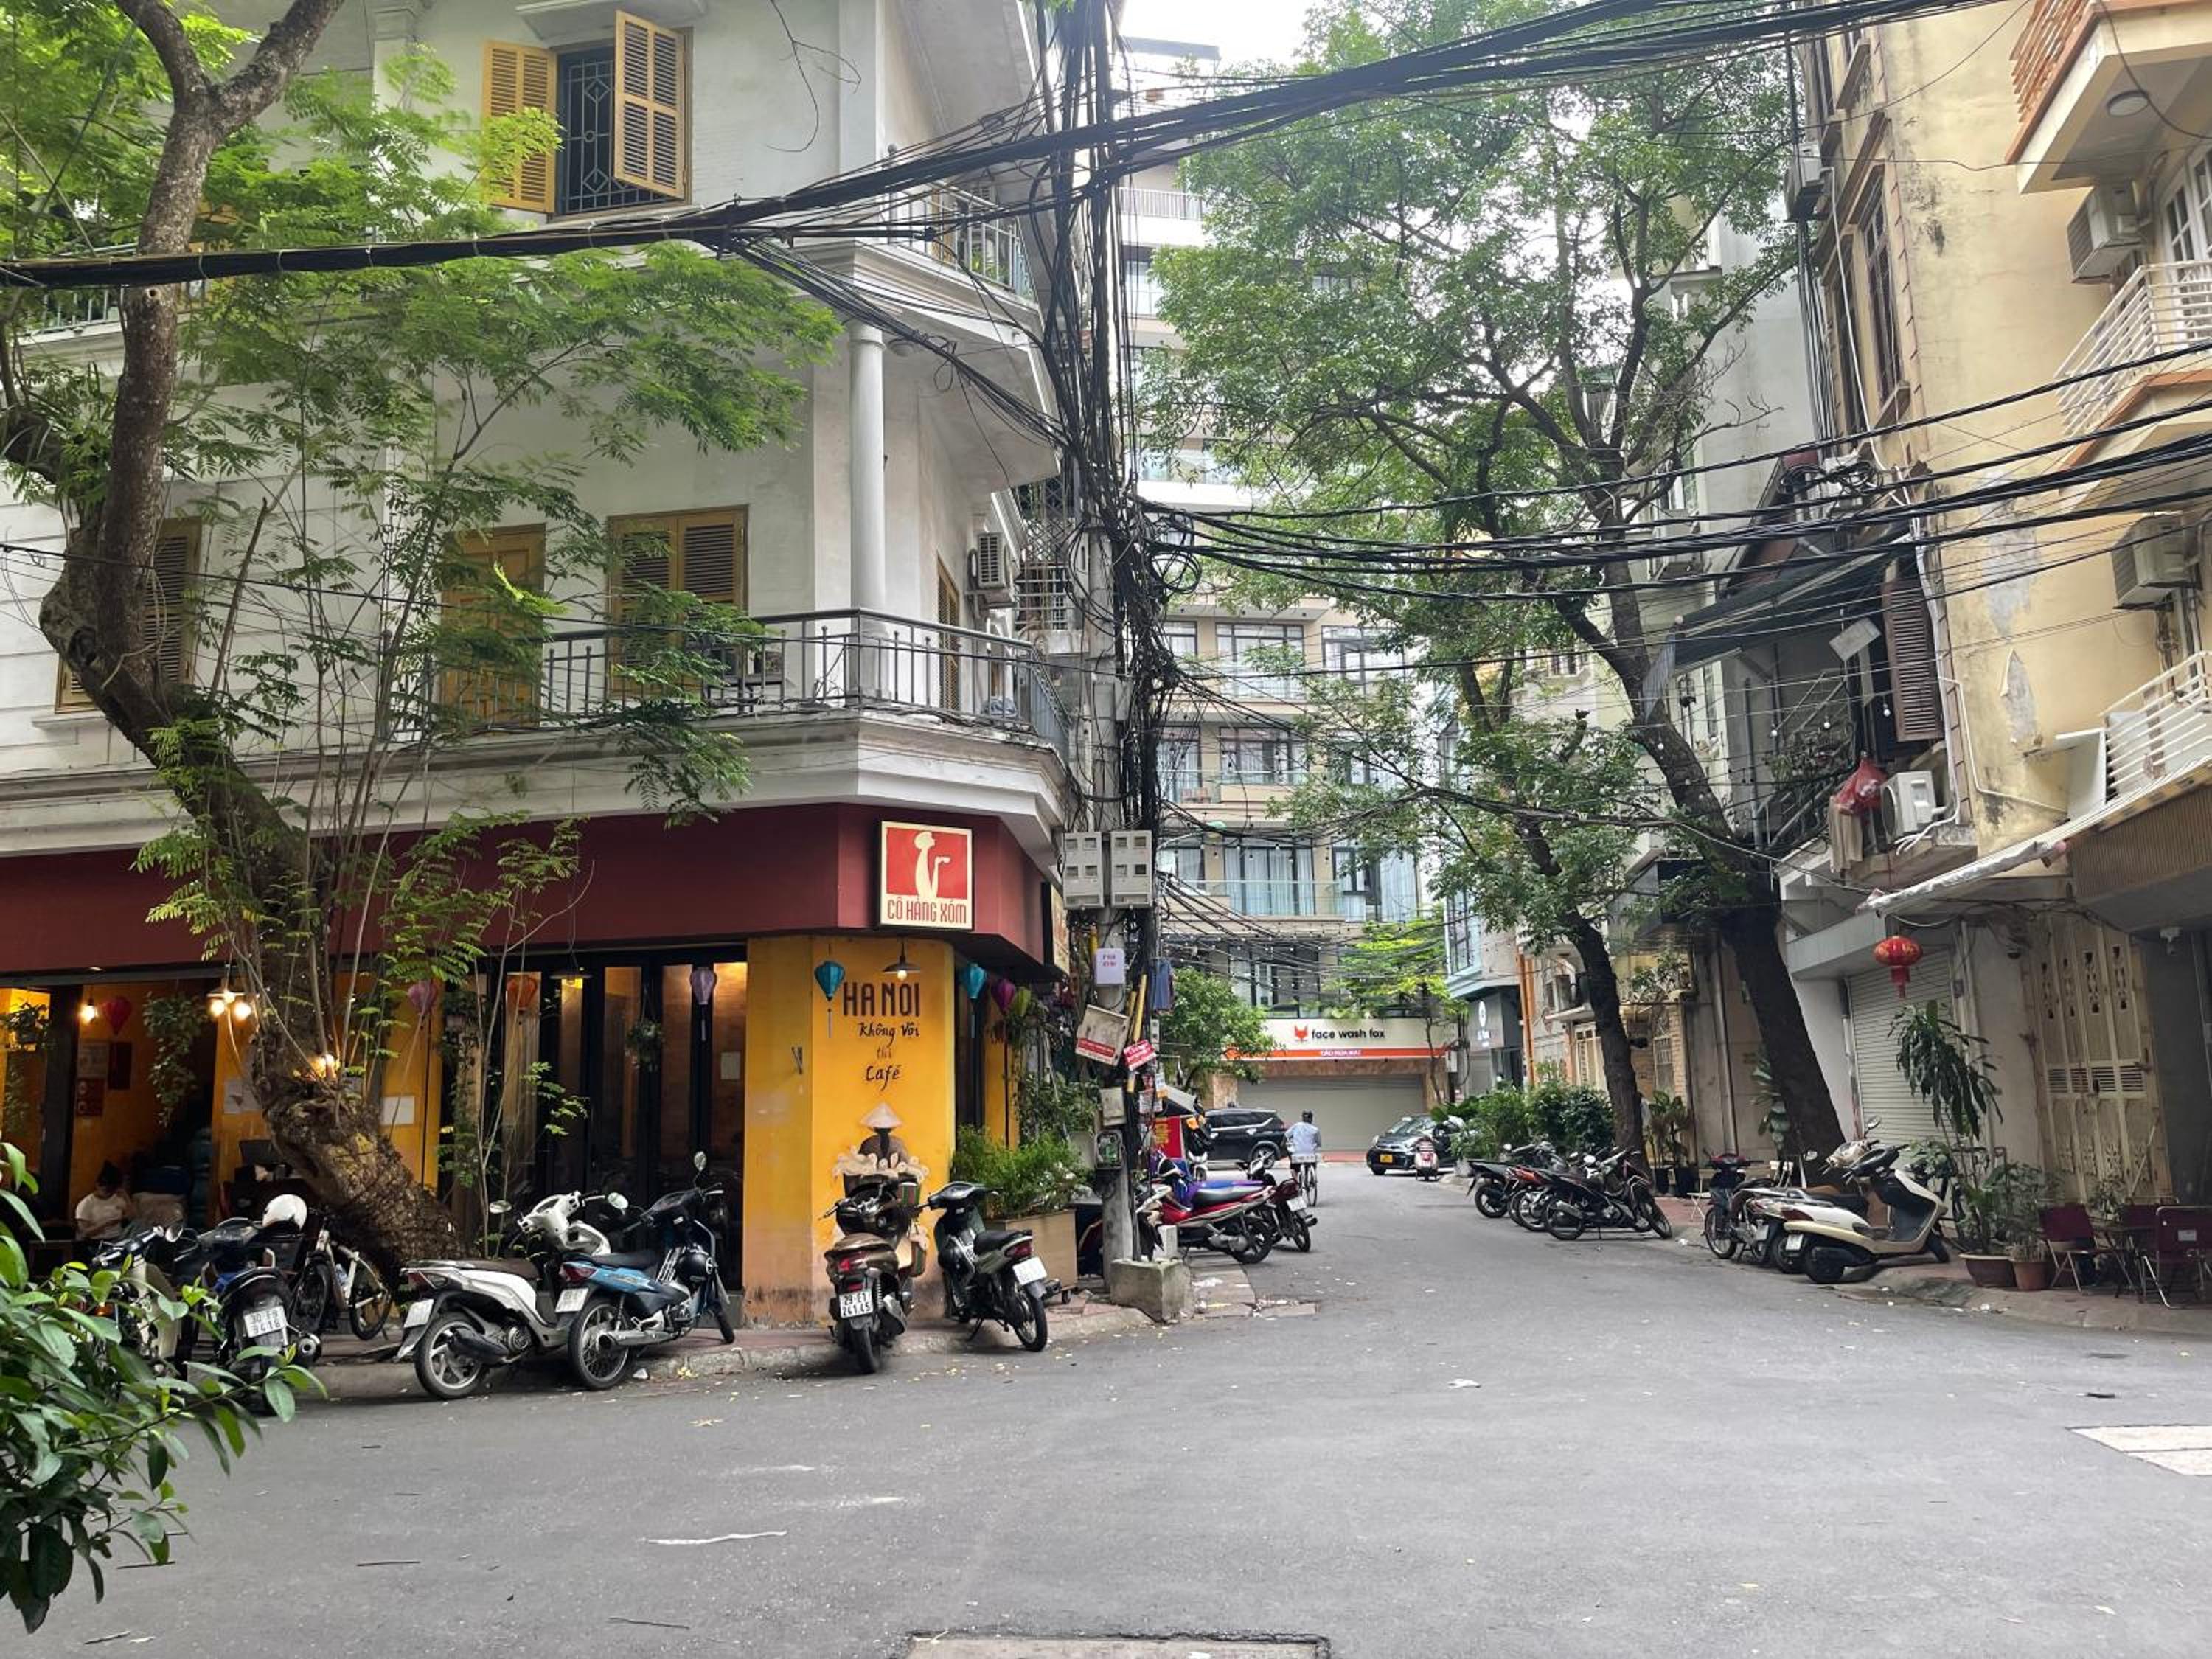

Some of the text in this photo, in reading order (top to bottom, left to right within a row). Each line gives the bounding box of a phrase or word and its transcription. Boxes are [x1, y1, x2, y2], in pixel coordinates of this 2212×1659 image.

[887, 896, 903, 919] CÔ
[940, 900, 967, 924] XÓM
[858, 1022, 895, 1048] Không
[1312, 1027, 1385, 1039] face wash fox
